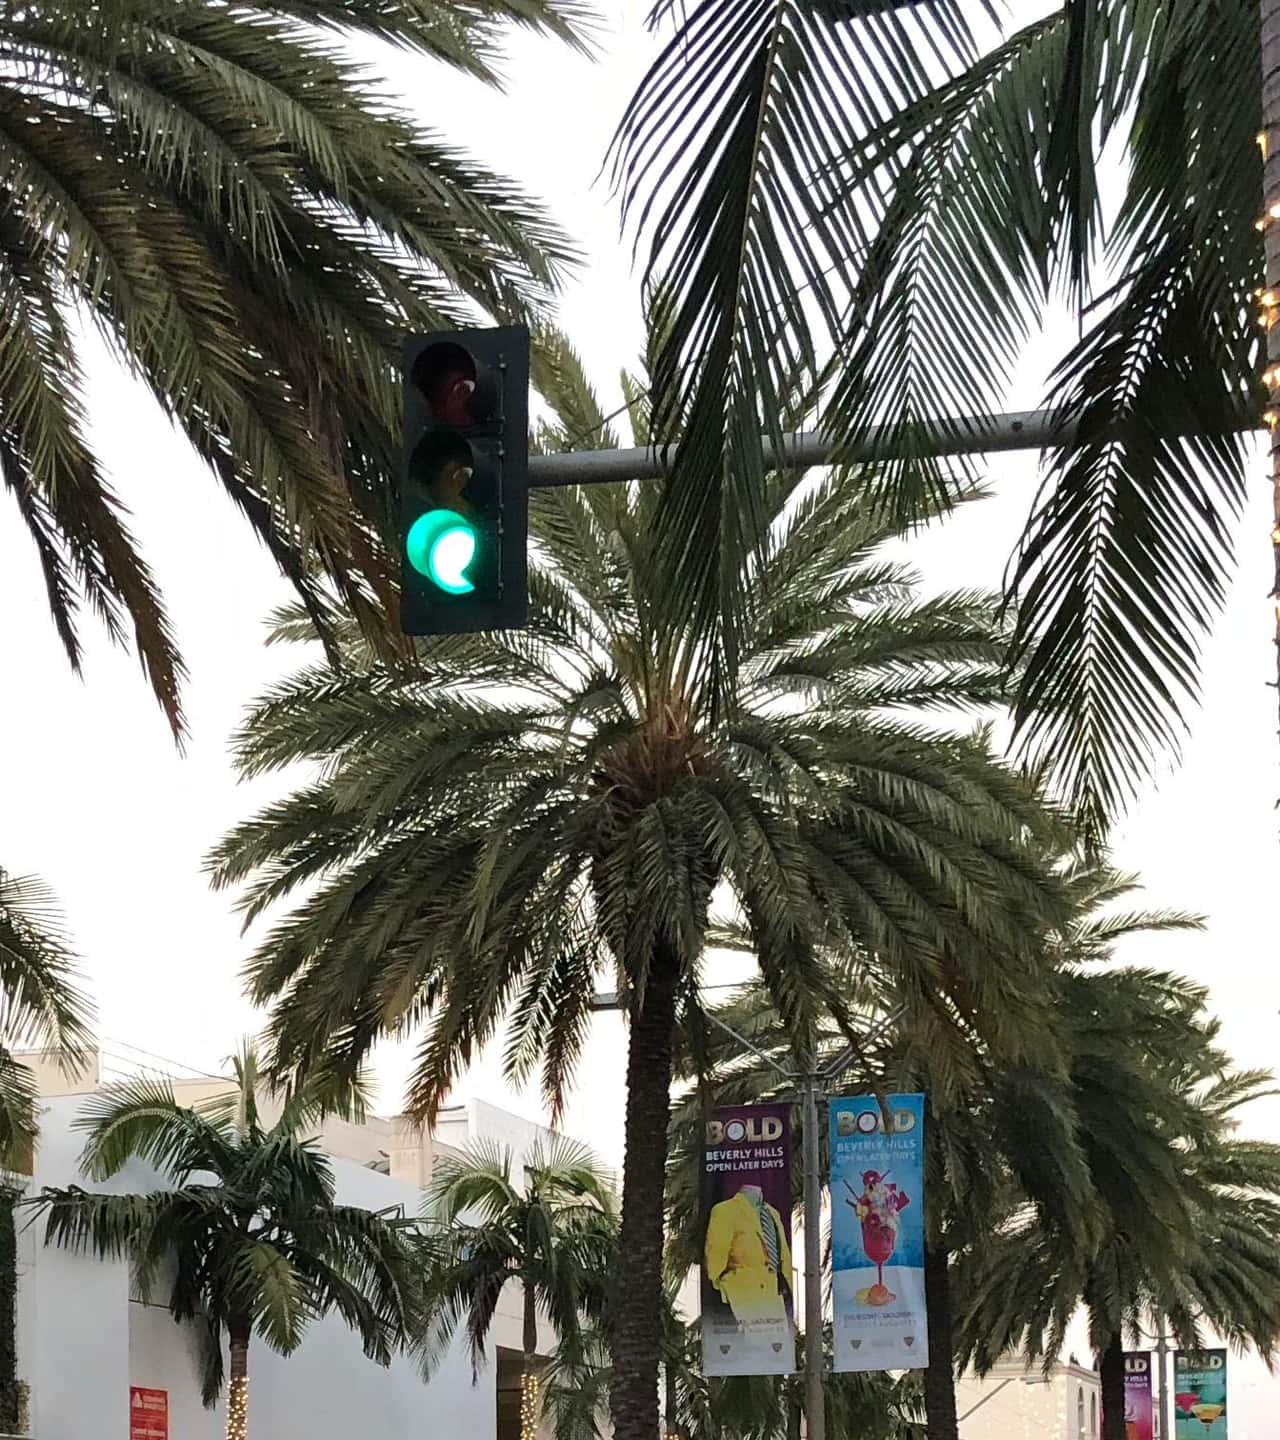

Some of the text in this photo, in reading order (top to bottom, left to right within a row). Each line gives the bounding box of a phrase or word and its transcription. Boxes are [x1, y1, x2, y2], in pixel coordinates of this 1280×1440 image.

[705, 1117, 783, 1145] BOLD
[706, 1147, 784, 1161] BEVERLY HILLS
[706, 1159, 784, 1172] OPEN LATER DAYS
[1125, 1358, 1147, 1372] LD
